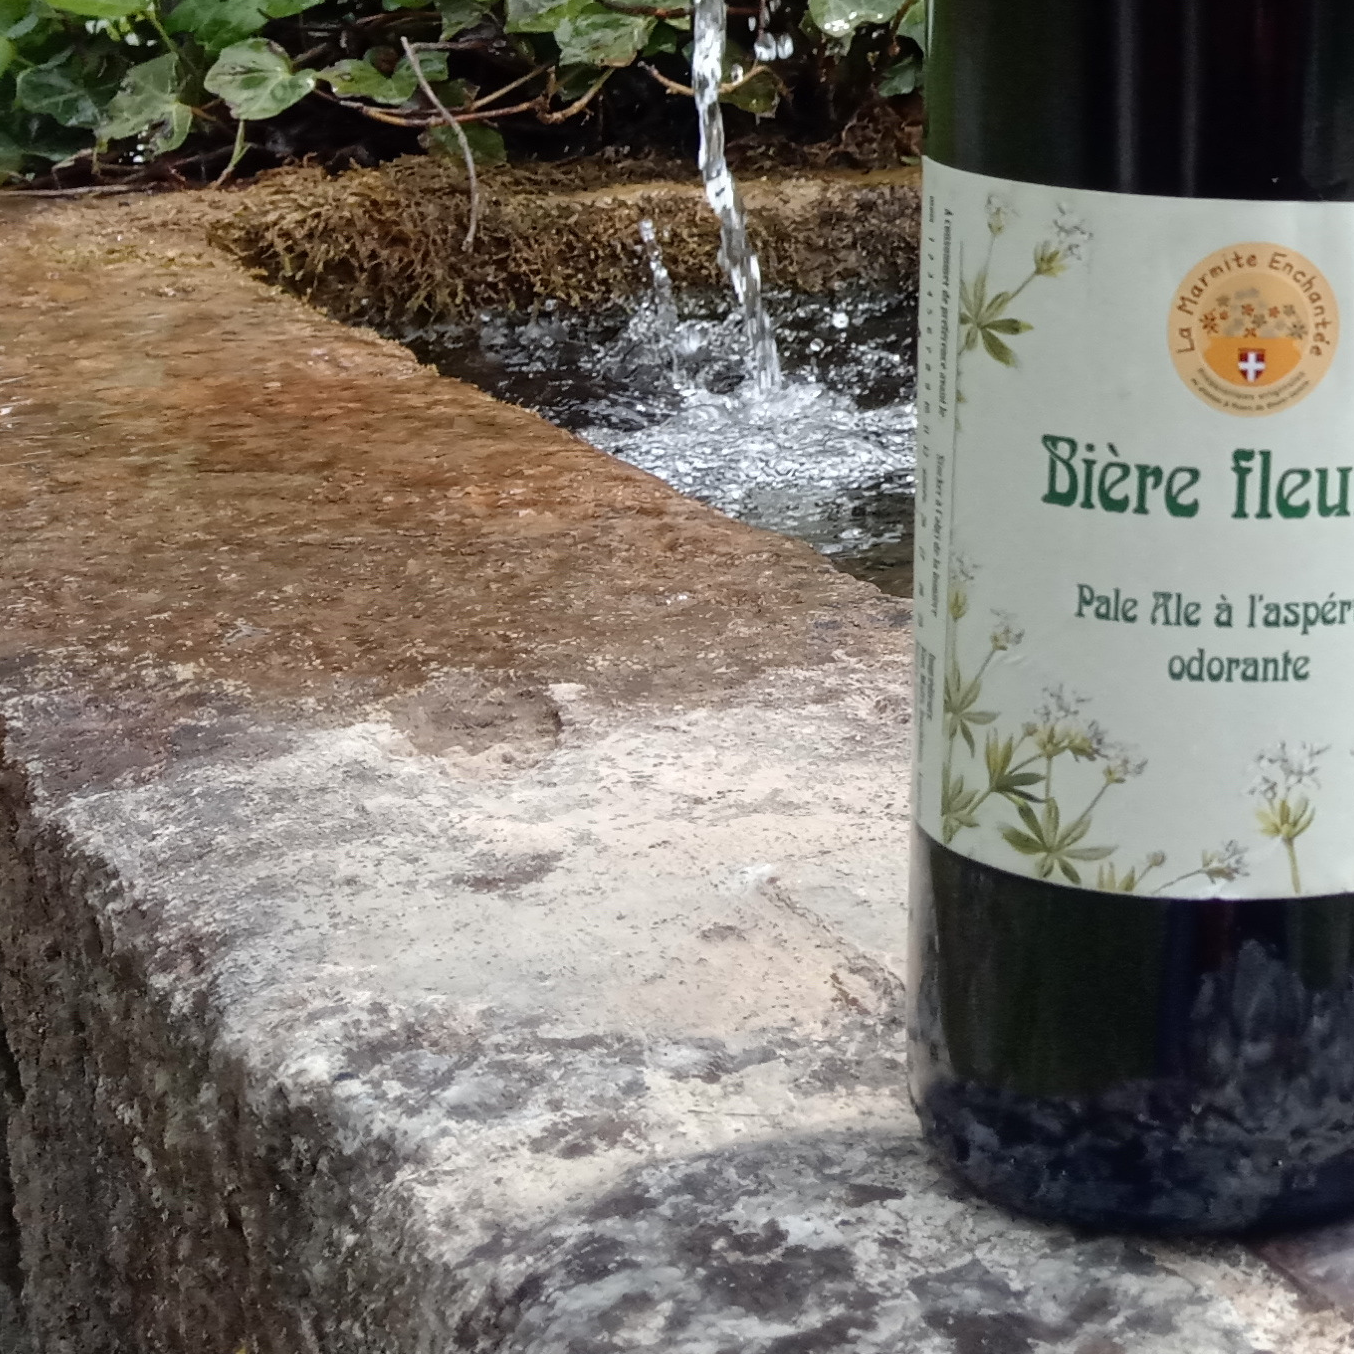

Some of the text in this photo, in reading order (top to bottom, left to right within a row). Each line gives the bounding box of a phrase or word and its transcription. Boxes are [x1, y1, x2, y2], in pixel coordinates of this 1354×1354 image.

[1176, 251, 1332, 356] La Marmite Enchantée
[1041, 434, 1200, 519] Bière
[1074, 583, 1138, 623] Pale
[1150, 591, 1201, 628] Ale
[1213, 594, 1233, 628] à
[1168, 647, 1311, 683] odorante
